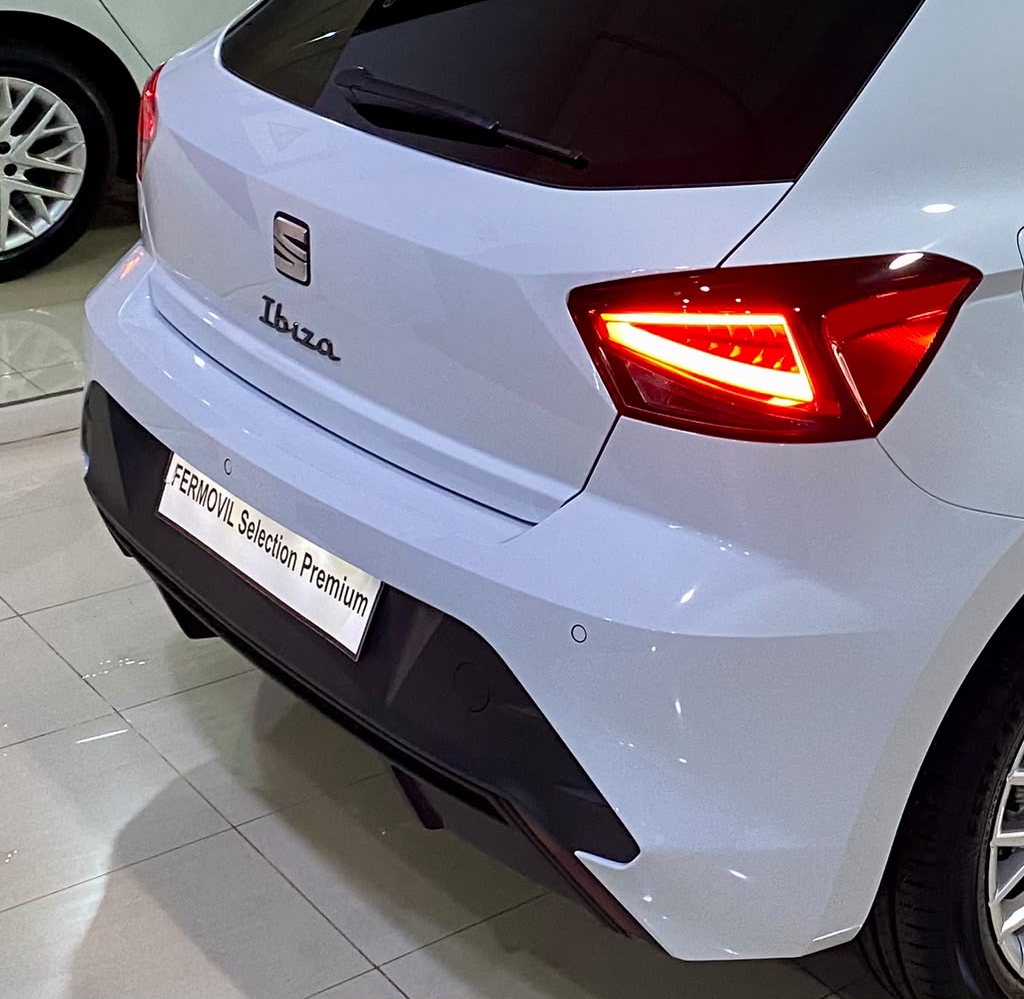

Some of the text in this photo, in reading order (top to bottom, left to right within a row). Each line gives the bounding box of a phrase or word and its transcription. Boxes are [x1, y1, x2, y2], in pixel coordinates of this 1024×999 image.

[259, 295, 341, 362] Ibiza
[171, 464, 369, 617] FERMOVIL Selection Premium
